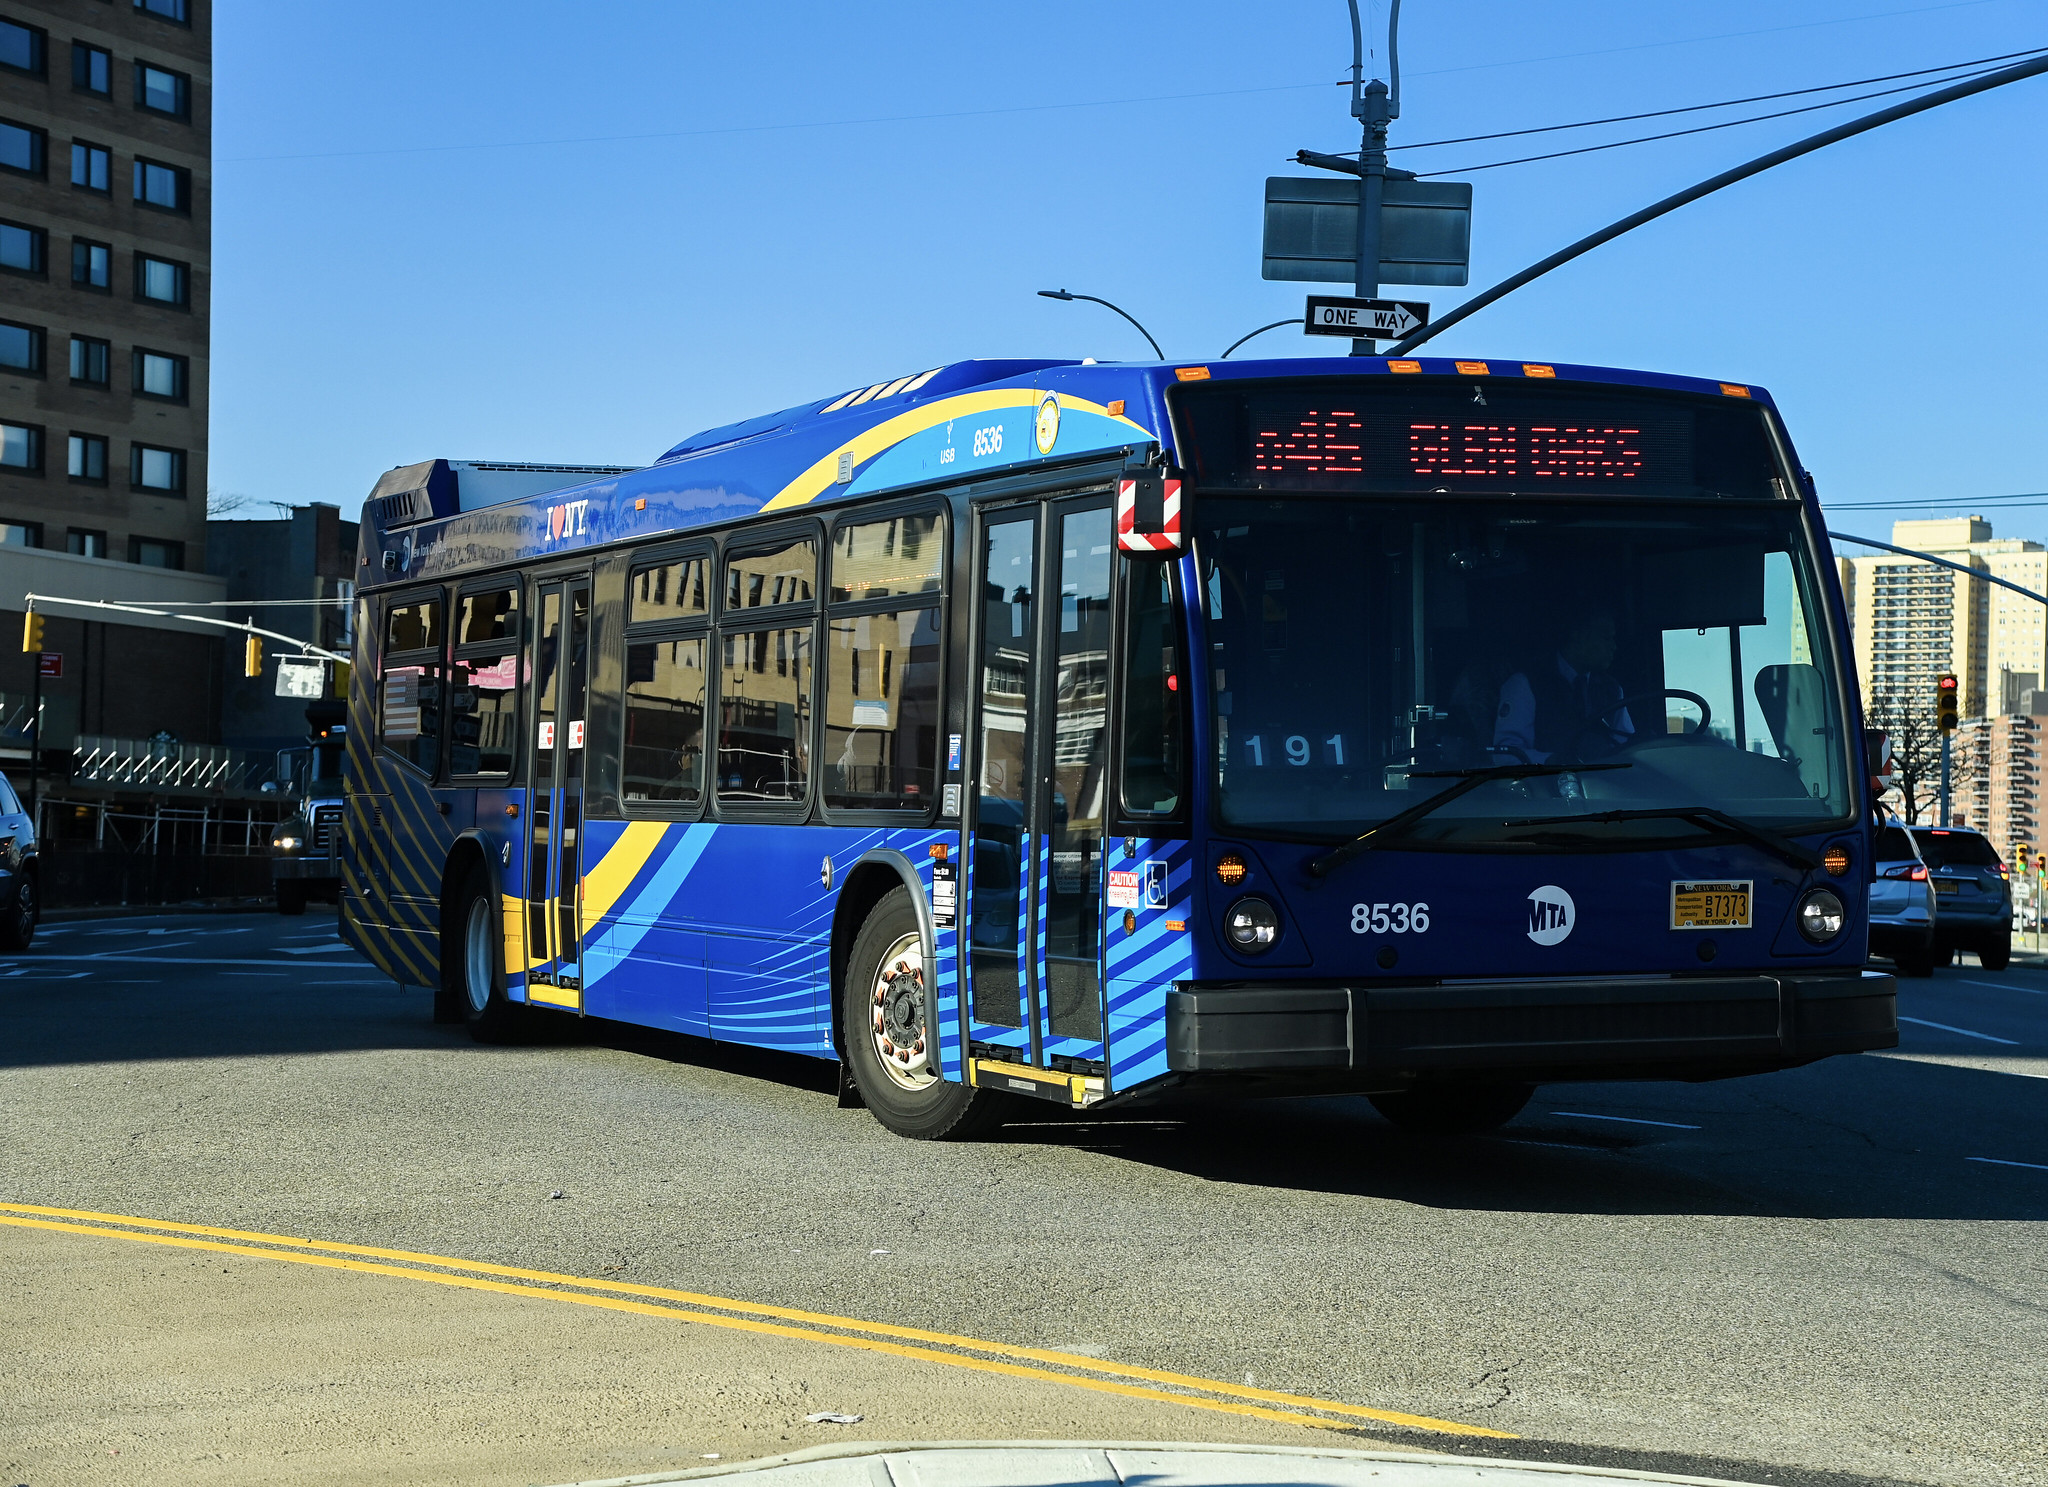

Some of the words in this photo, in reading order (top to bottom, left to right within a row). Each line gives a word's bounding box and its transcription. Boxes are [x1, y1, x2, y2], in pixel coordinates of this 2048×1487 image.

[1323, 308, 1358, 325] ONE
[1374, 312, 1410, 329] WAY
[940, 447, 955, 464] USB
[973, 424, 1003, 457] 8536
[1410, 424, 1516, 475] GLEN
[1531, 427, 1642, 477] OAKS
[562, 499, 589, 538] NY
[1108, 889, 1128, 901] Kneeling
[1129, 889, 1138, 900] Bus
[1109, 872, 1139, 887] CAUTION
[1350, 902, 1430, 934] 8536
[1527, 899, 1567, 934] MTA
